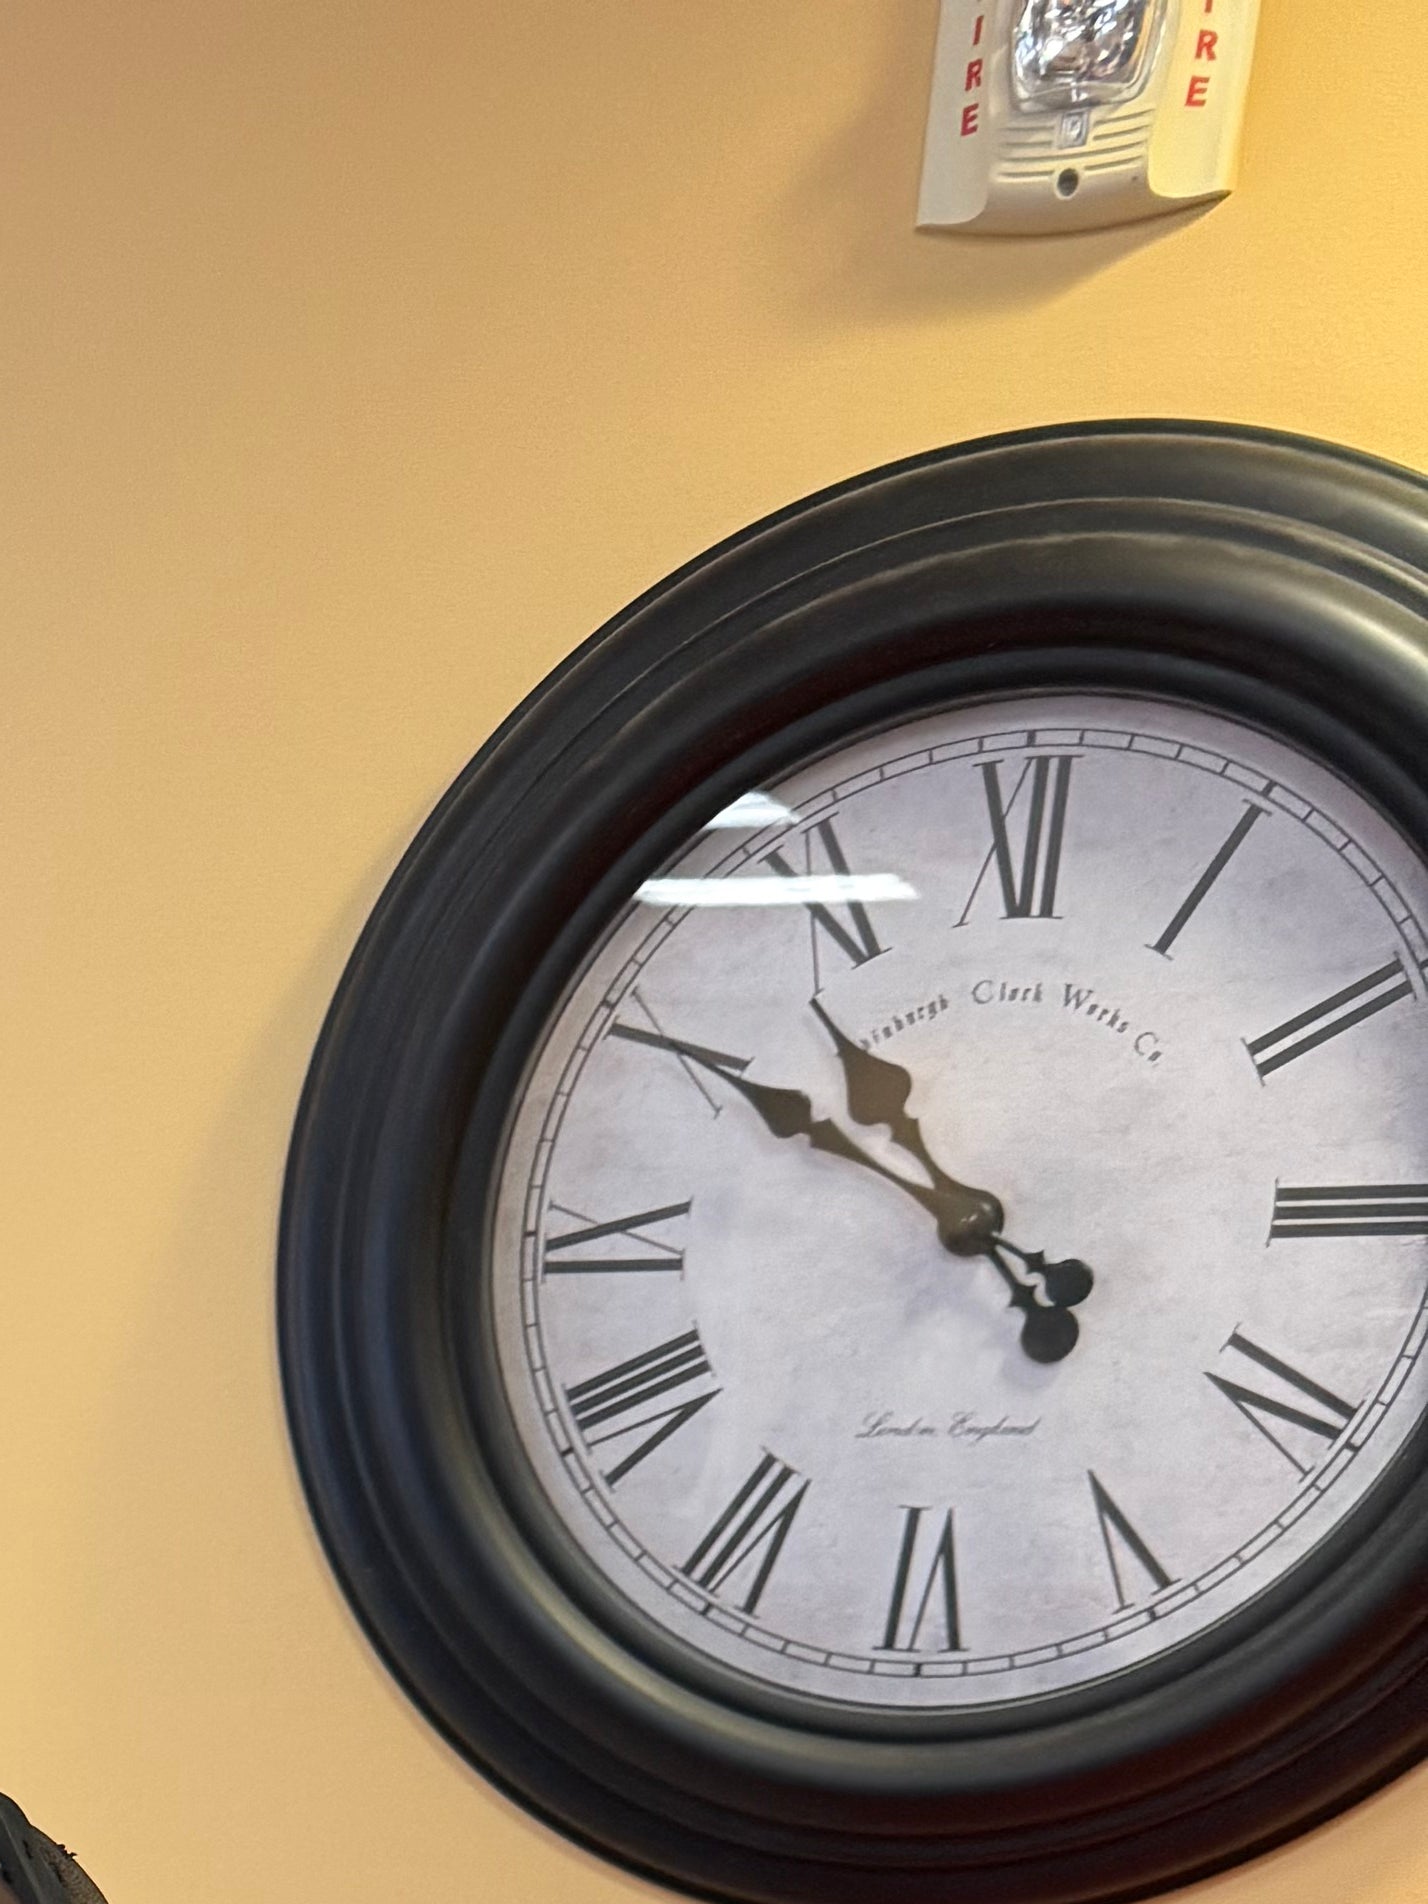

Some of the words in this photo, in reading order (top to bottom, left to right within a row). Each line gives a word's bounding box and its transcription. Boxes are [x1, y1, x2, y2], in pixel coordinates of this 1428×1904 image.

[959, 0, 986, 137] IRE
[952, 755, 1085, 929] XII
[1144, 798, 1273, 961] I
[970, 979, 1044, 1005] Clock
[1063, 982, 1129, 1035] Works
[1240, 950, 1418, 1087] II
[540, 1196, 694, 1283] IX
[560, 1319, 724, 1494] VIII
[947, 1410, 1042, 1448] England
[1202, 1321, 1375, 1485] IV
[672, 1445, 812, 1620] VII
[872, 1504, 971, 1654] VI
[1086, 1469, 1182, 1615] V
